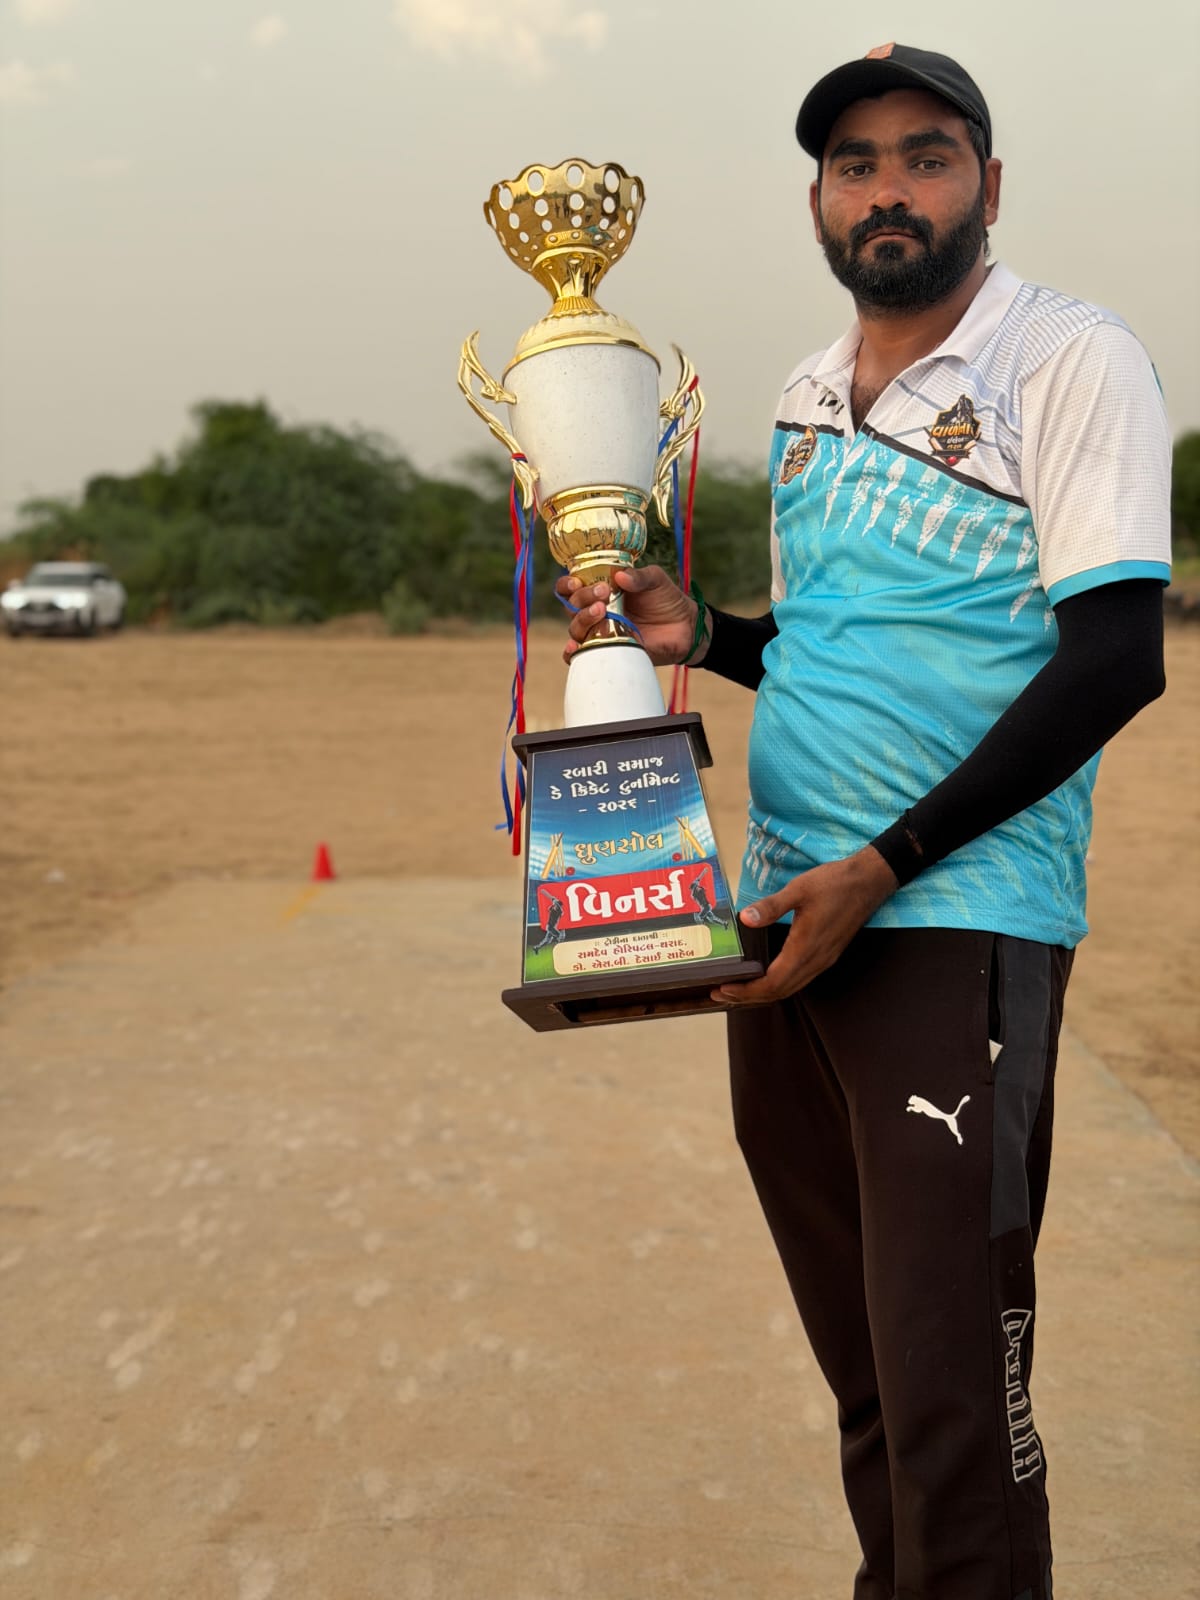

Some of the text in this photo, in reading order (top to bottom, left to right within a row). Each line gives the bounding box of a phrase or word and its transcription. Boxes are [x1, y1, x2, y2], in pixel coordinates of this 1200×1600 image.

[562, 756, 664, 780] રબારી સમાજ
[550, 785, 562, 800] ડે
[571, 782, 610, 798] ક્રિકેટ
[566, 869, 685, 922] વિનર્સ
[577, 947, 608, 959] રામદેવ
[667, 948, 695, 960] સાહેબ
